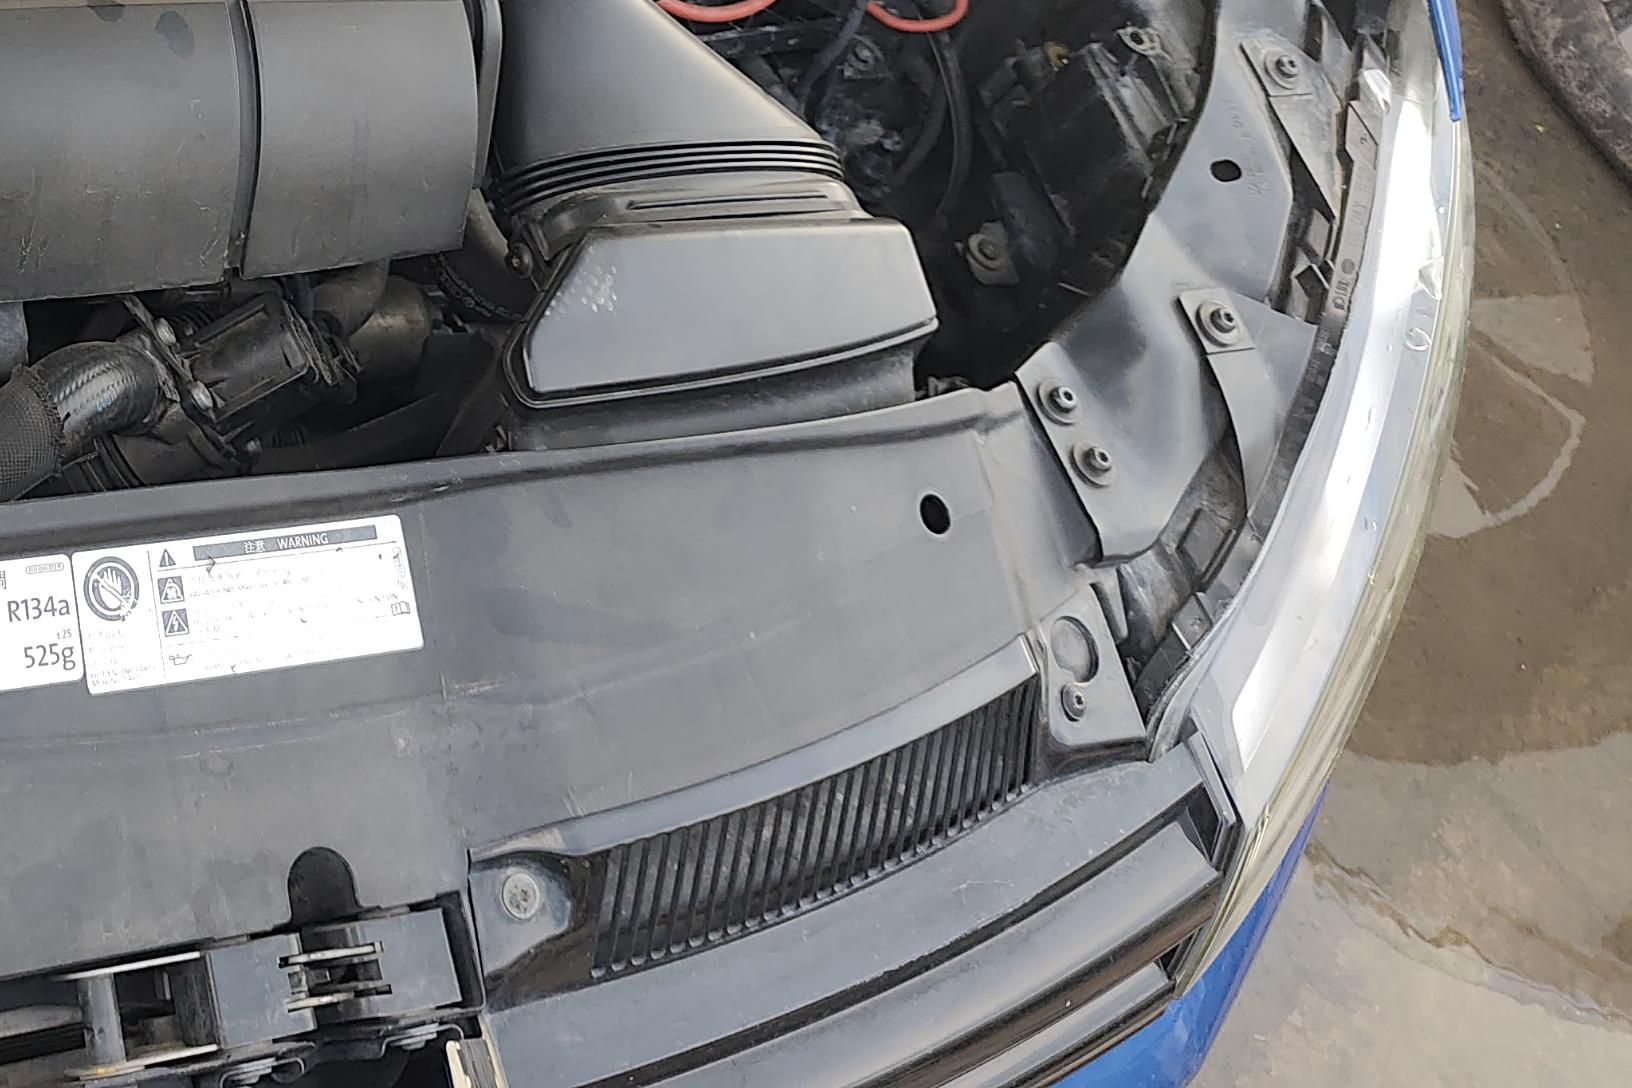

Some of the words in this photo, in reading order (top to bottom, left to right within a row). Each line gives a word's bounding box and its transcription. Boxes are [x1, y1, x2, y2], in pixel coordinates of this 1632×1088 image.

[277, 532, 329, 550] WARNING
[7, 596, 71, 623] R134a
[23, 642, 77, 672] 525g
